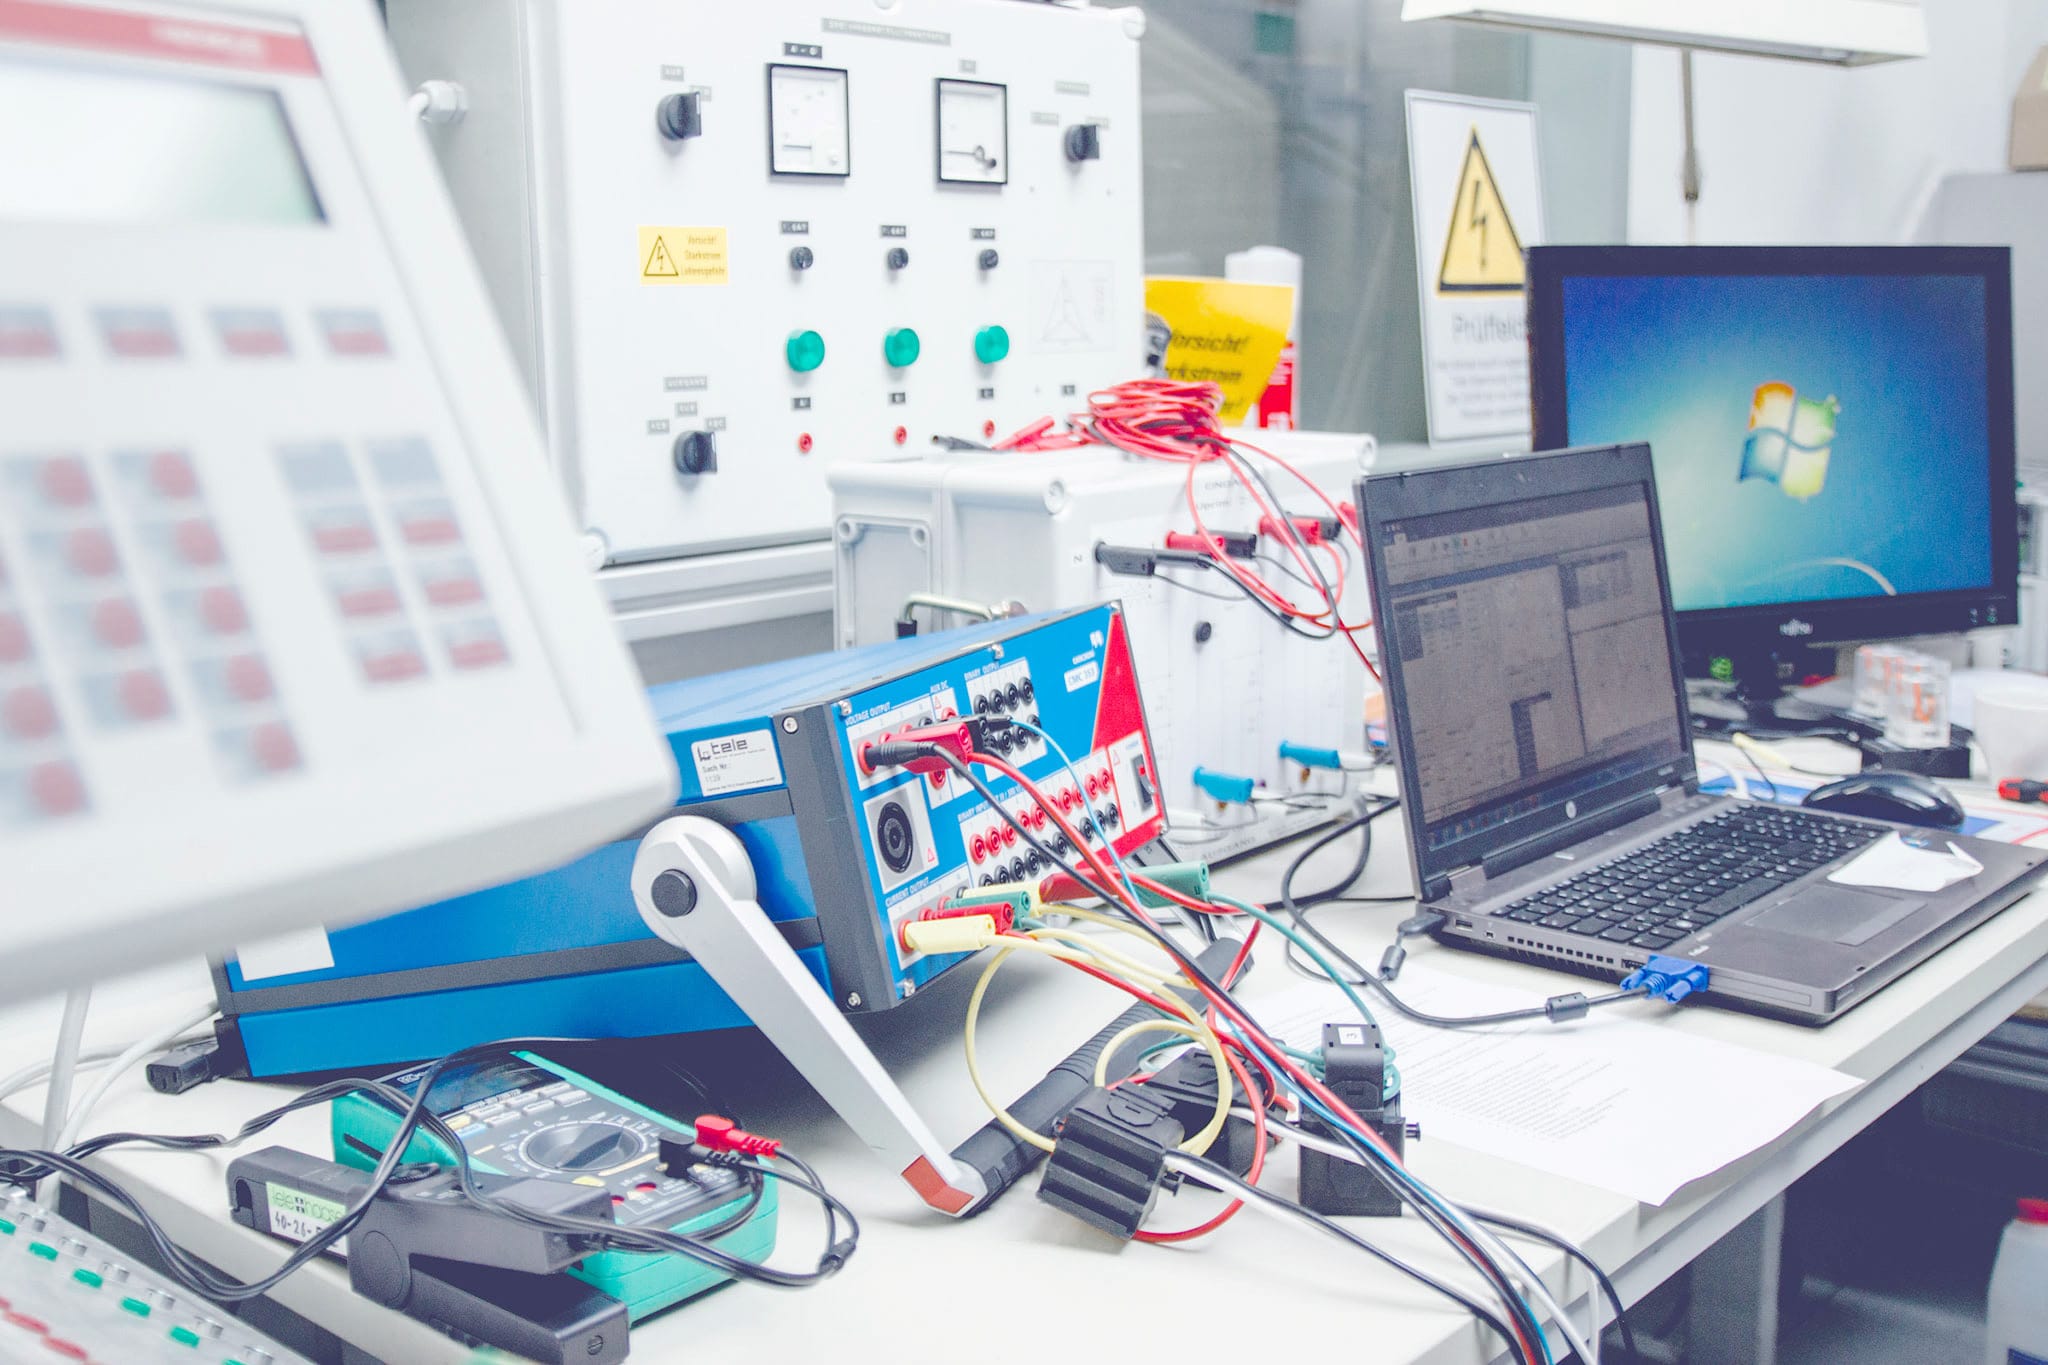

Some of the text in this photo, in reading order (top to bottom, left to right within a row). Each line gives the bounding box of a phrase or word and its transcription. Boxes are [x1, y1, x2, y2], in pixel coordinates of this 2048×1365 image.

[844, 701, 891, 727] VOLTAGE OUTPUT
[711, 738, 748, 755] tele
[884, 876, 930, 908] CURRENT OUTPUT
